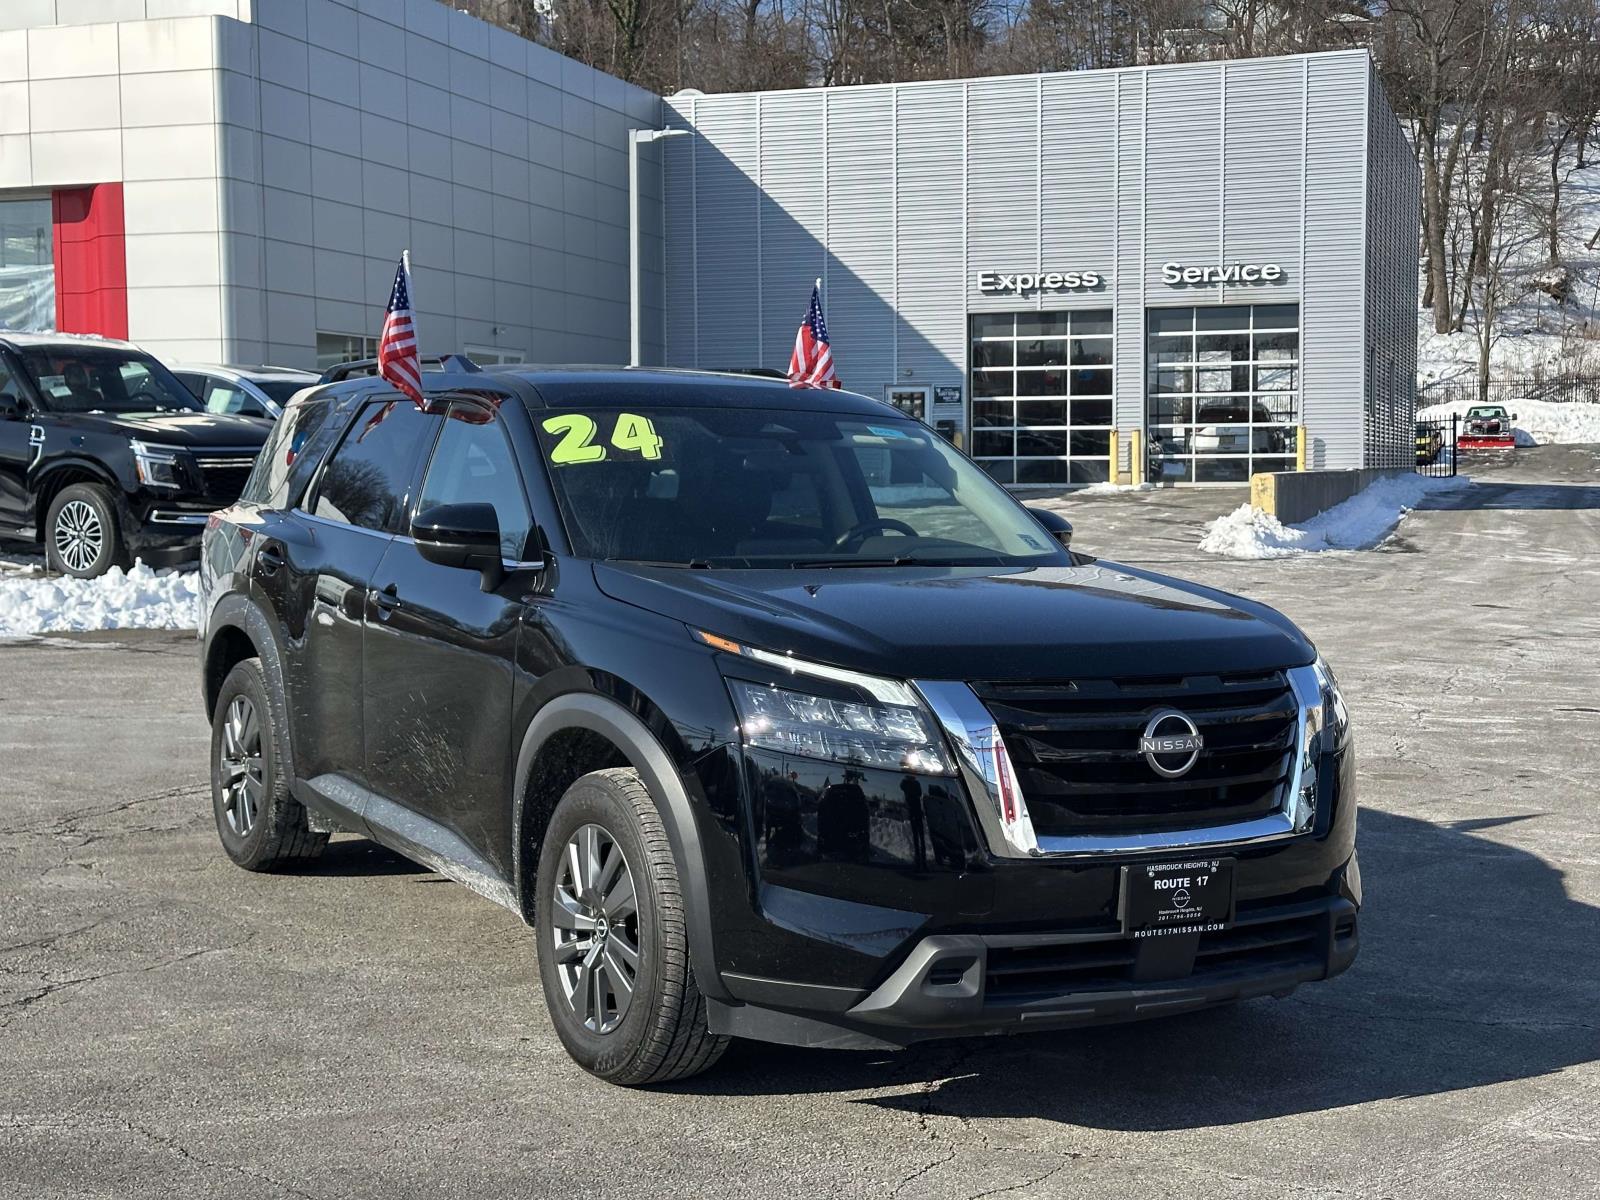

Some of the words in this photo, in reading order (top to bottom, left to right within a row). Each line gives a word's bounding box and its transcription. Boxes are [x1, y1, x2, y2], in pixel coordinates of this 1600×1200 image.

[976, 270, 1099, 293] Express
[1160, 260, 1282, 284] Service
[542, 413, 664, 464] 24
[1143, 738, 1203, 751] NISSAN
[1146, 863, 1183, 872] HASBROUCK
[1154, 878, 1191, 890] ROUTE
[1196, 875, 1209, 886] 17
[1134, 923, 1225, 938] ROUTE17NISSAN.COM
